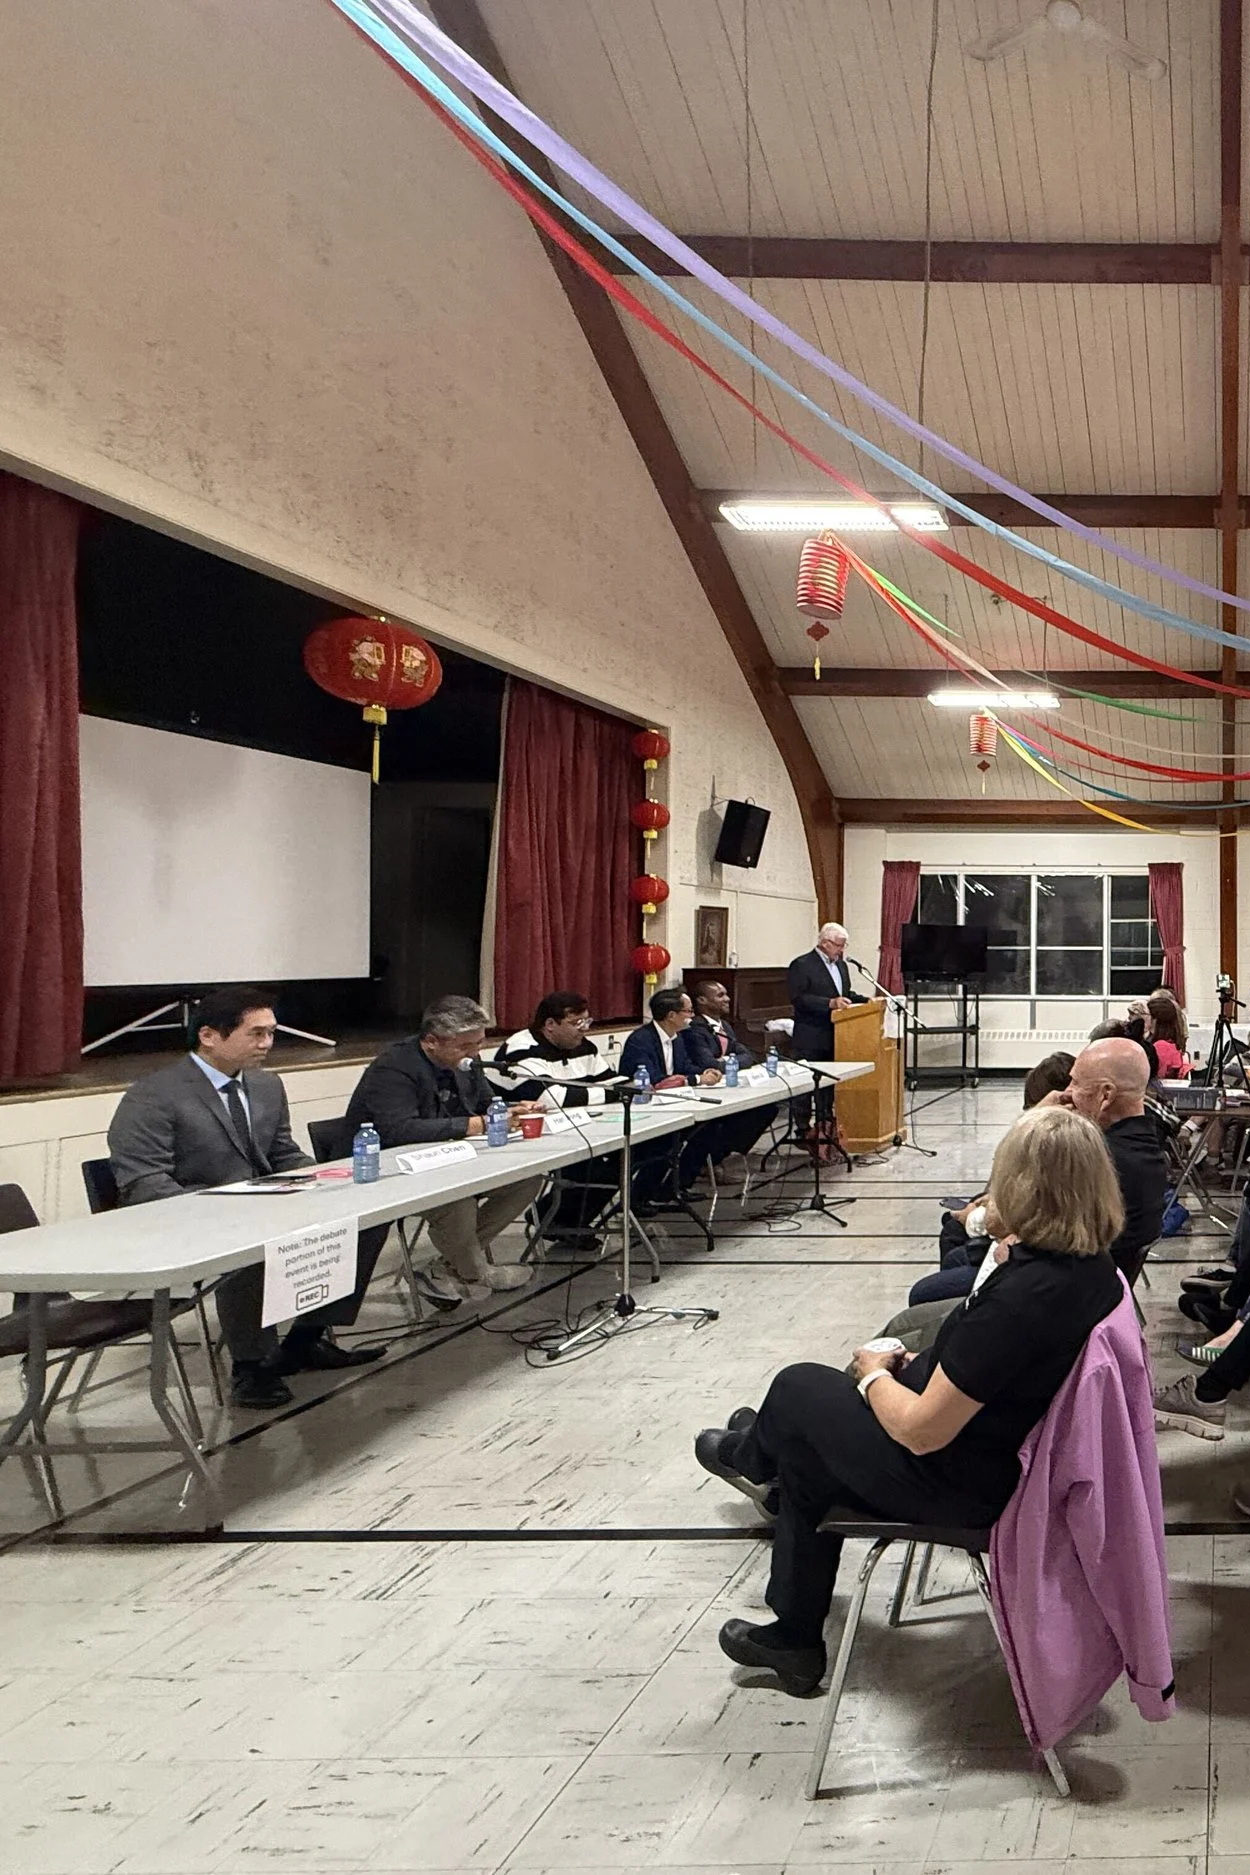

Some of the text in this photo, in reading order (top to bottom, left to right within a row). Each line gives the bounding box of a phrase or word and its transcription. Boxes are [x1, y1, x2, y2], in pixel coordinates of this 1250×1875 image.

[303, 1237, 319, 1247] The
[320, 1228, 348, 1242] debate
[285, 1243, 342, 1267] portion of this
[285, 1255, 341, 1279] event is being
[305, 1291, 320, 1302] REC
